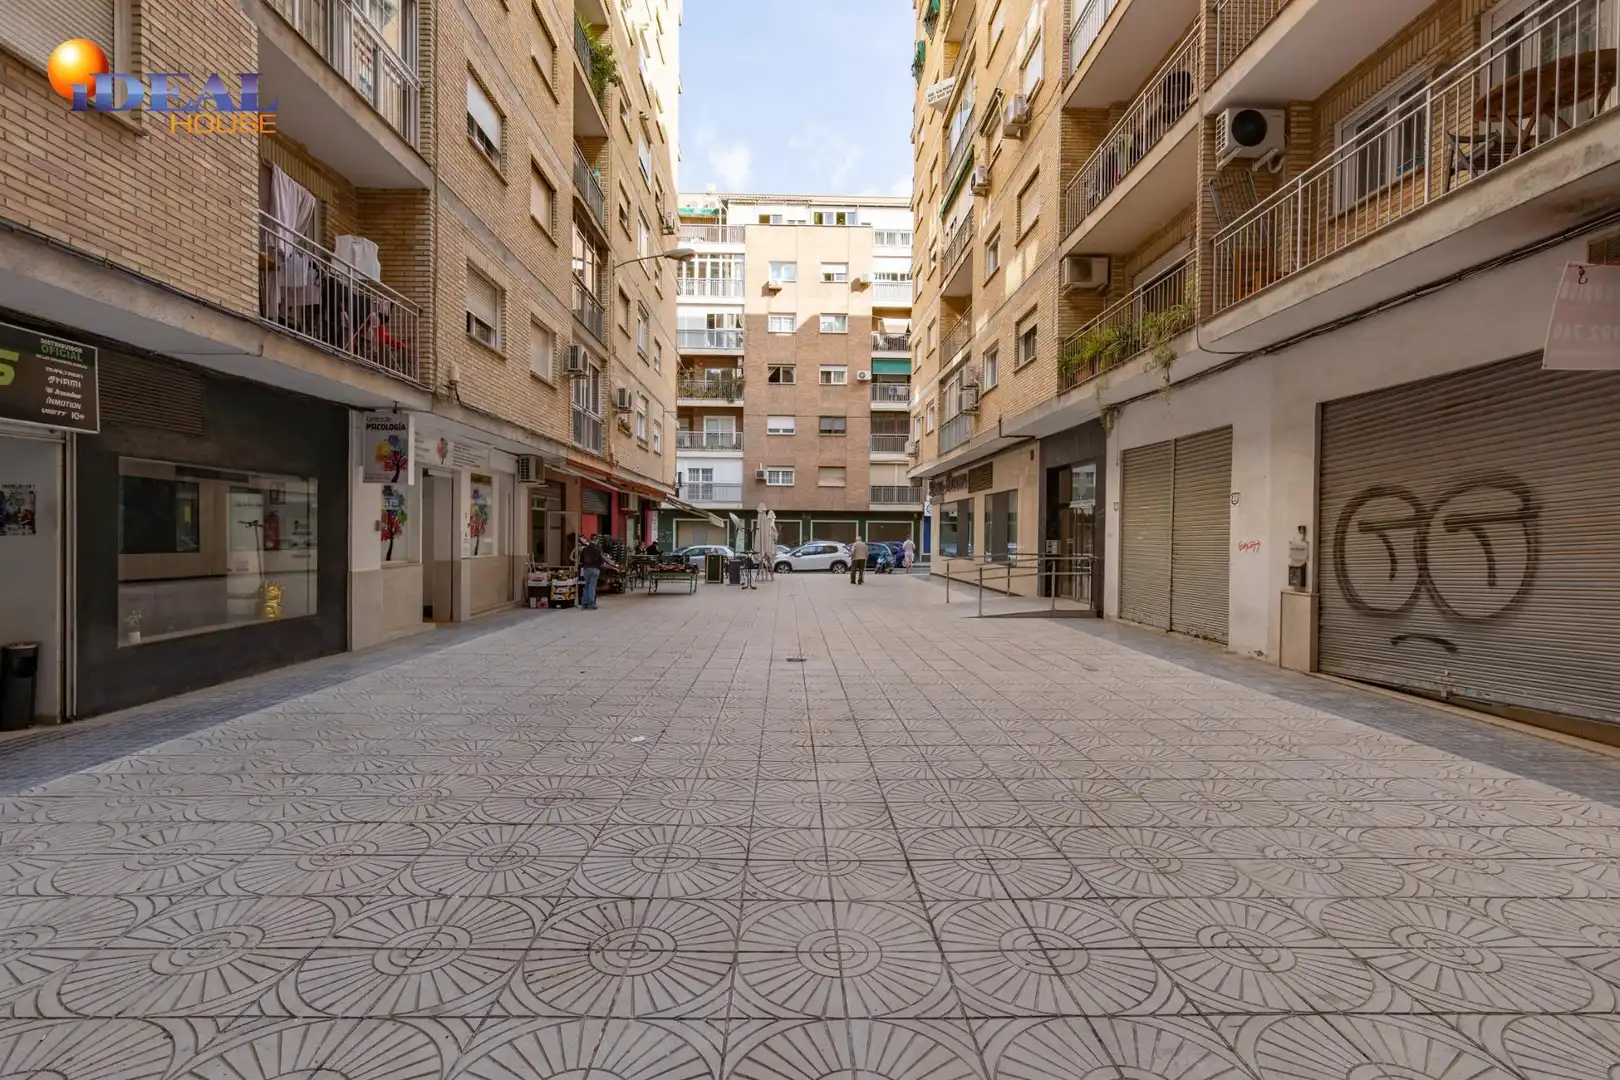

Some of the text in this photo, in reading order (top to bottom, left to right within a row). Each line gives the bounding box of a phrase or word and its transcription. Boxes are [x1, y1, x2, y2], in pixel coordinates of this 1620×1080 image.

[40, 338, 83, 354] DISTRIBUIDOR
[41, 344, 83, 362] OFICIAL
[366, 421, 406, 431] PSICOLOGÍA
